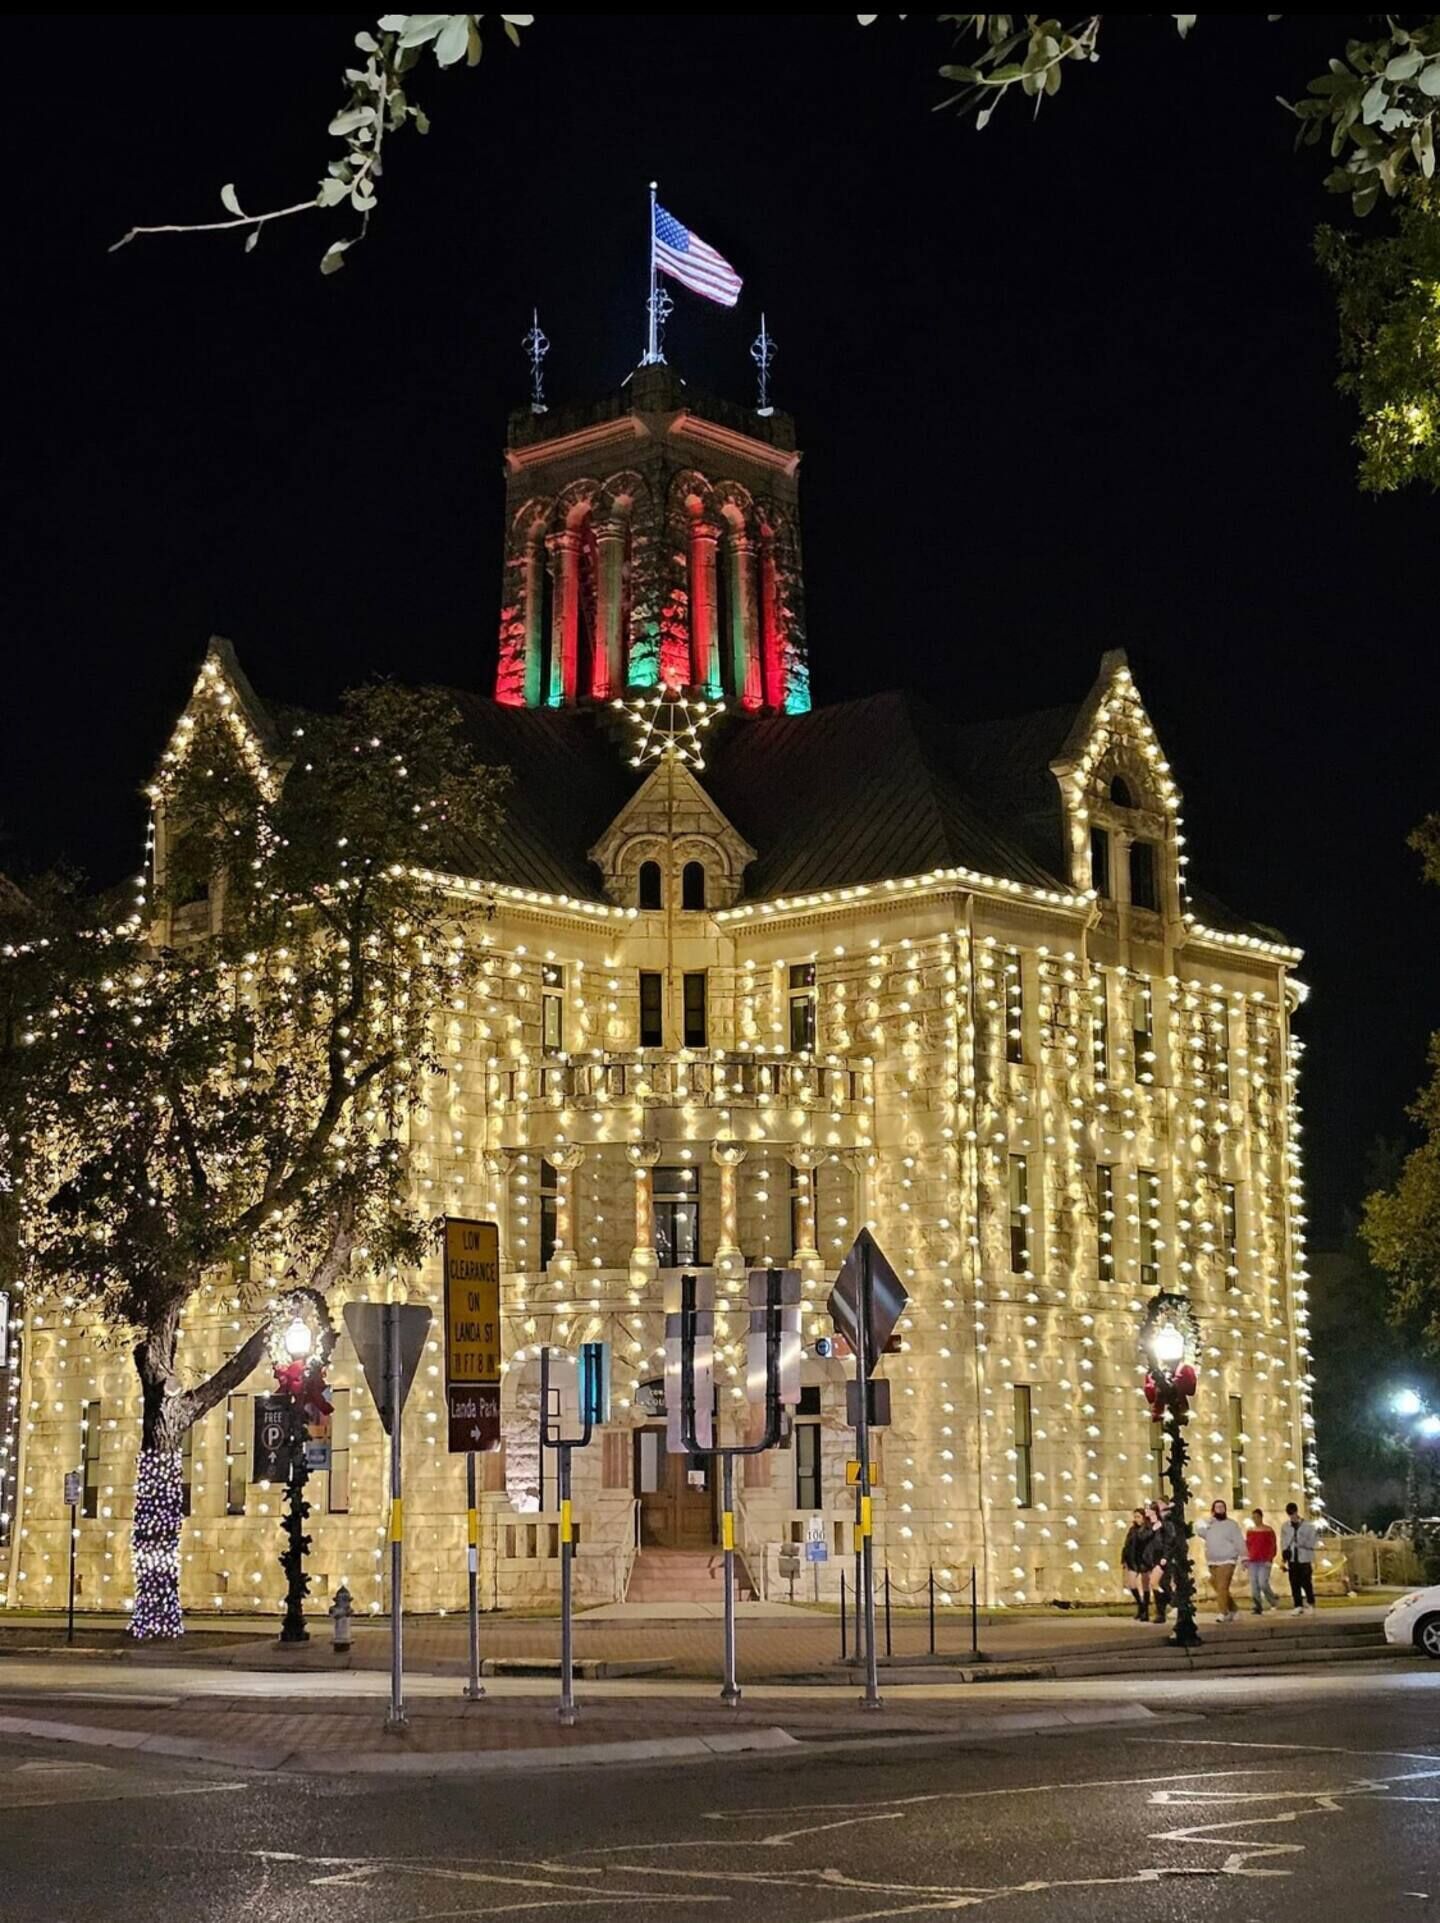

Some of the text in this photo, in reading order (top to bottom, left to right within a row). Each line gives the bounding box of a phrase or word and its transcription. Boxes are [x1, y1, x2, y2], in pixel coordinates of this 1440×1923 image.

[462, 1230, 480, 1250] LOW
[450, 1258, 496, 1282] CLEARANCE
[467, 1291, 480, 1313] ON
[455, 1321, 493, 1344] LANDA ST
[464, 1353, 474, 1373] FT
[264, 1411, 282, 1423] FREE
[451, 1397, 498, 1418] Landa Park
[268, 1427, 280, 1446] P
